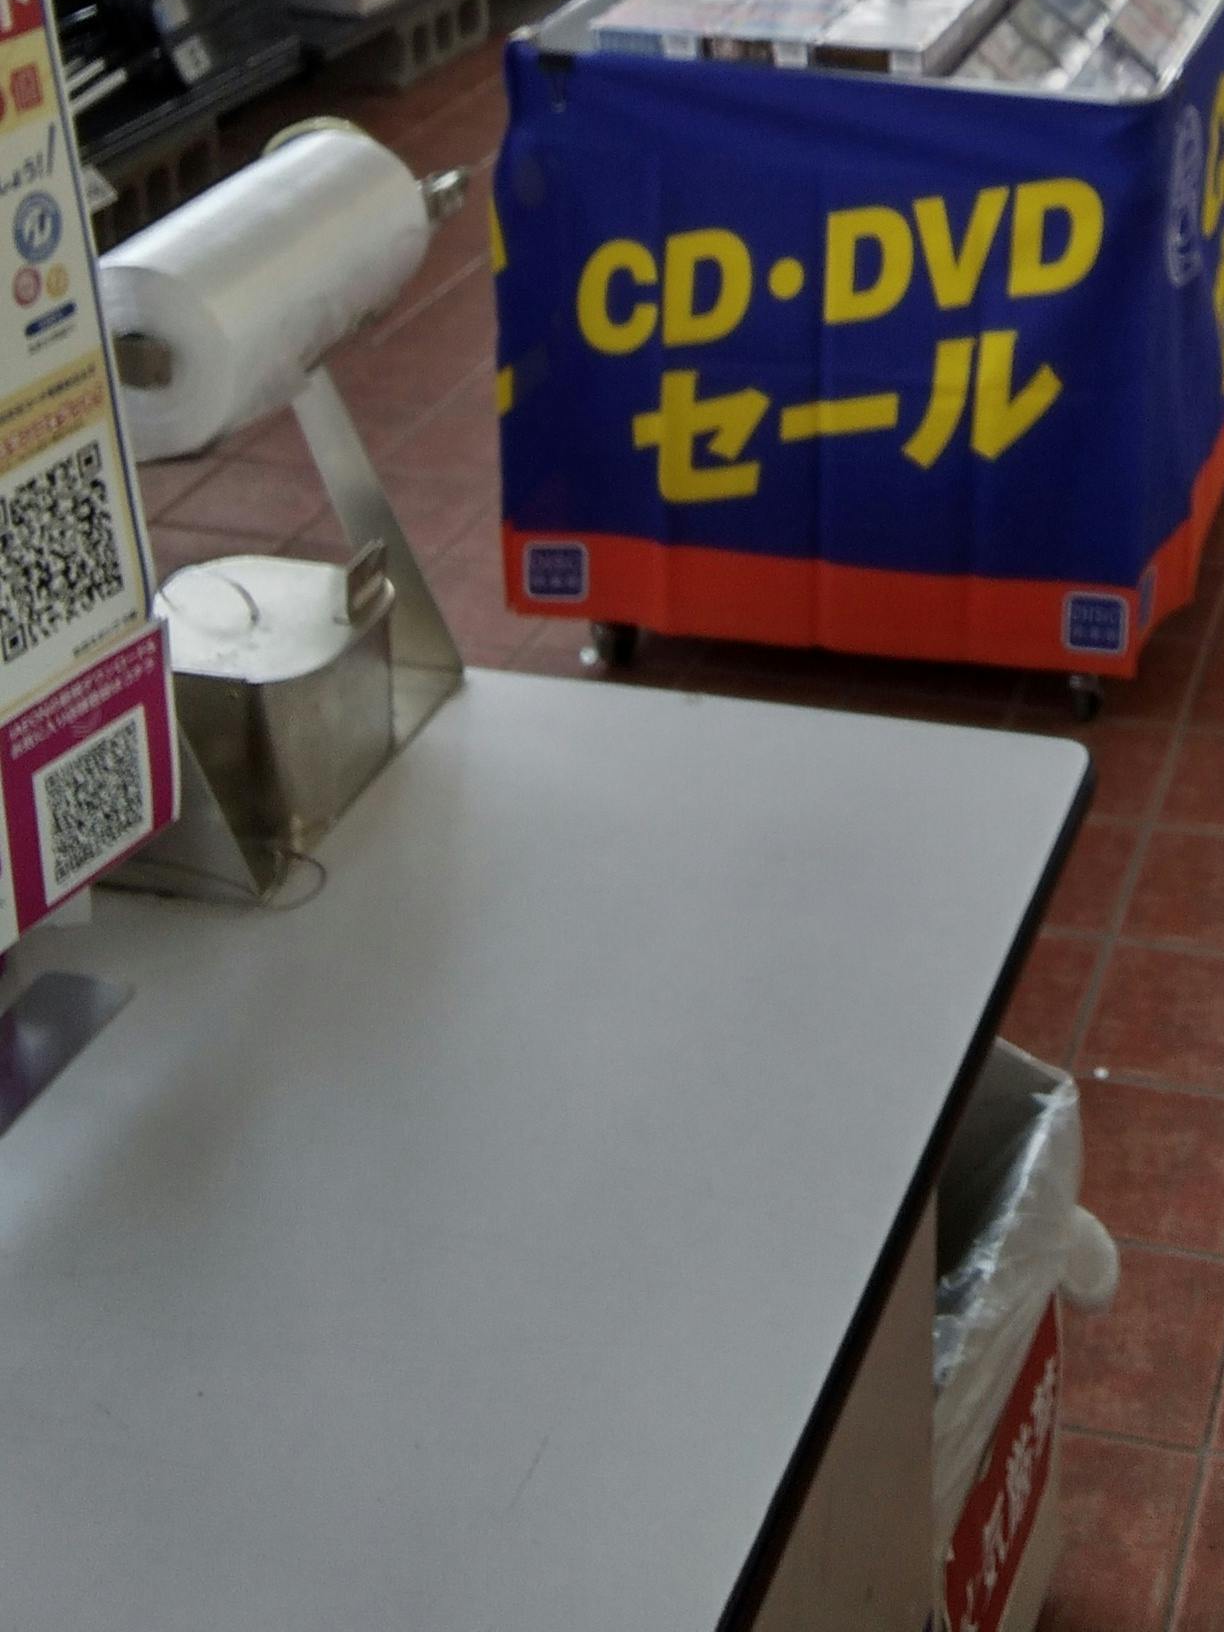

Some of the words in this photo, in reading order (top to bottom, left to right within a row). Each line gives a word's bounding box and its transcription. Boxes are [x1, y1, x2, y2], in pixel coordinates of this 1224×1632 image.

[576, 177, 1105, 356] CD・DVD
[632, 329, 1064, 505] セール
